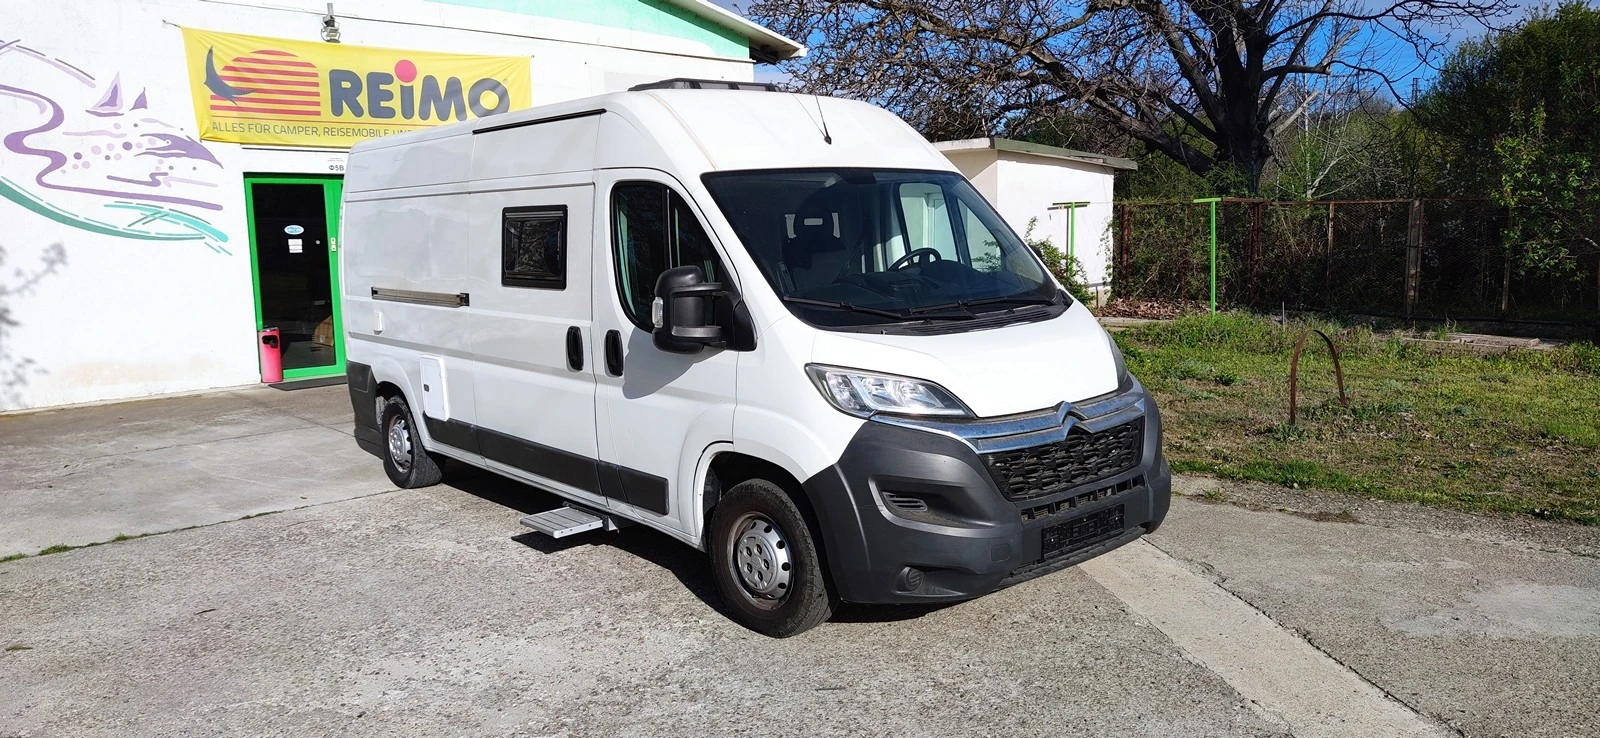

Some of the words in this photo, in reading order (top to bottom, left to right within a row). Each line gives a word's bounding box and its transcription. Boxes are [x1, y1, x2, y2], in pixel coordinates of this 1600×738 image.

[212, 121, 246, 133] ALLES
[248, 122, 271, 134] FÜR
[273, 124, 321, 137] CAMPER,
[323, 126, 389, 138] REISEMOBILE
